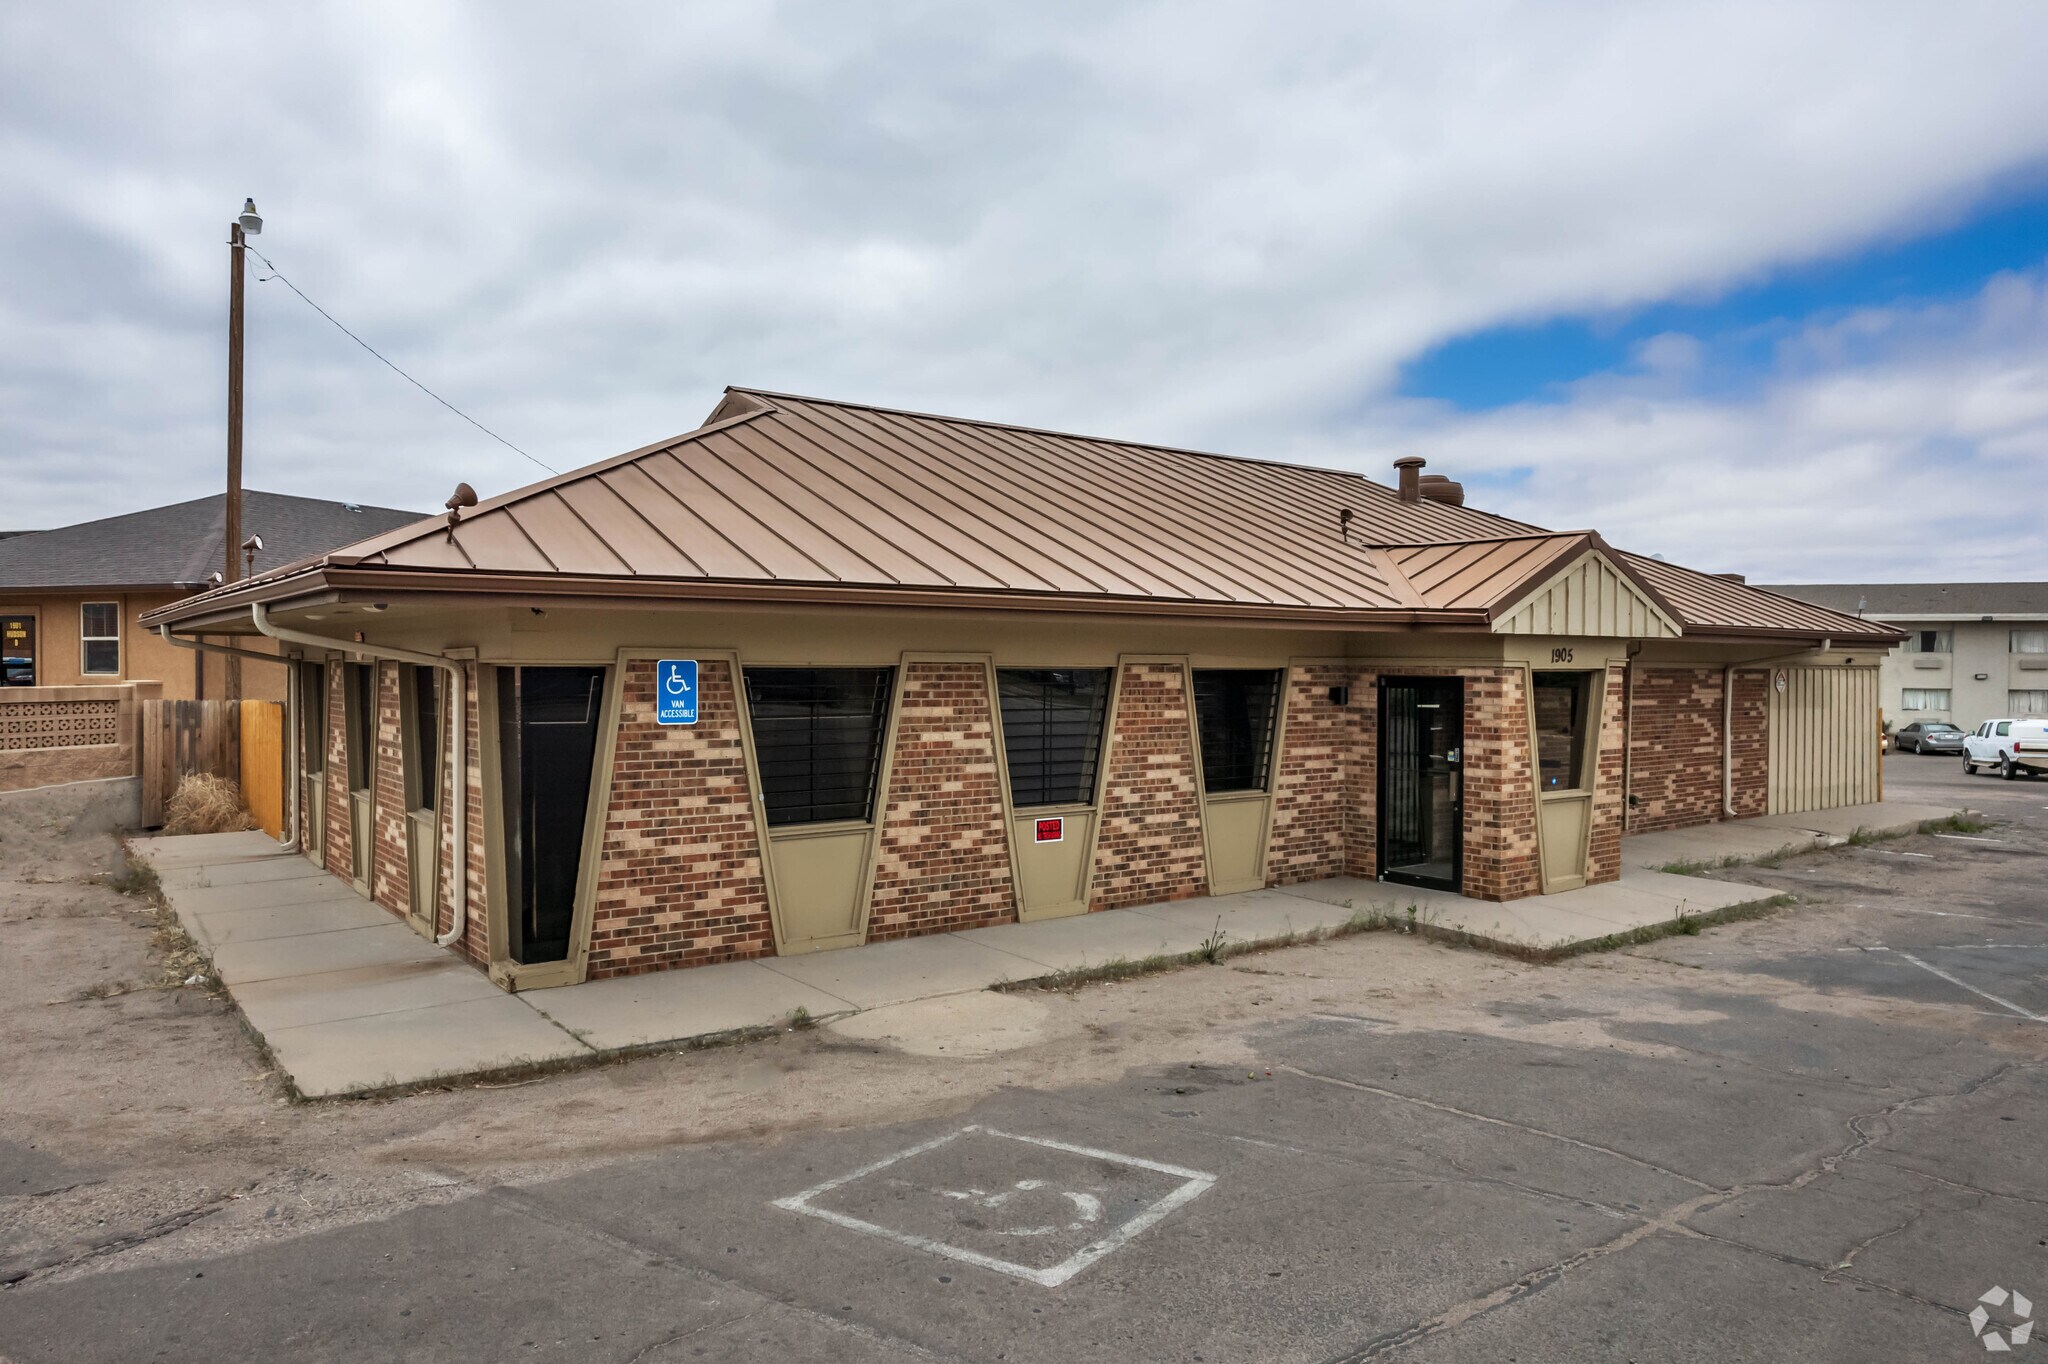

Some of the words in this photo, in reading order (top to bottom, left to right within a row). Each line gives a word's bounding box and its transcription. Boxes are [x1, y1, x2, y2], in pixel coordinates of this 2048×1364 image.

[1551, 647, 1573, 663] 1905
[671, 700, 685, 708] VAN
[660, 709, 695, 718] ACCESSIBLE
[1038, 820, 1060, 831] POSTED
